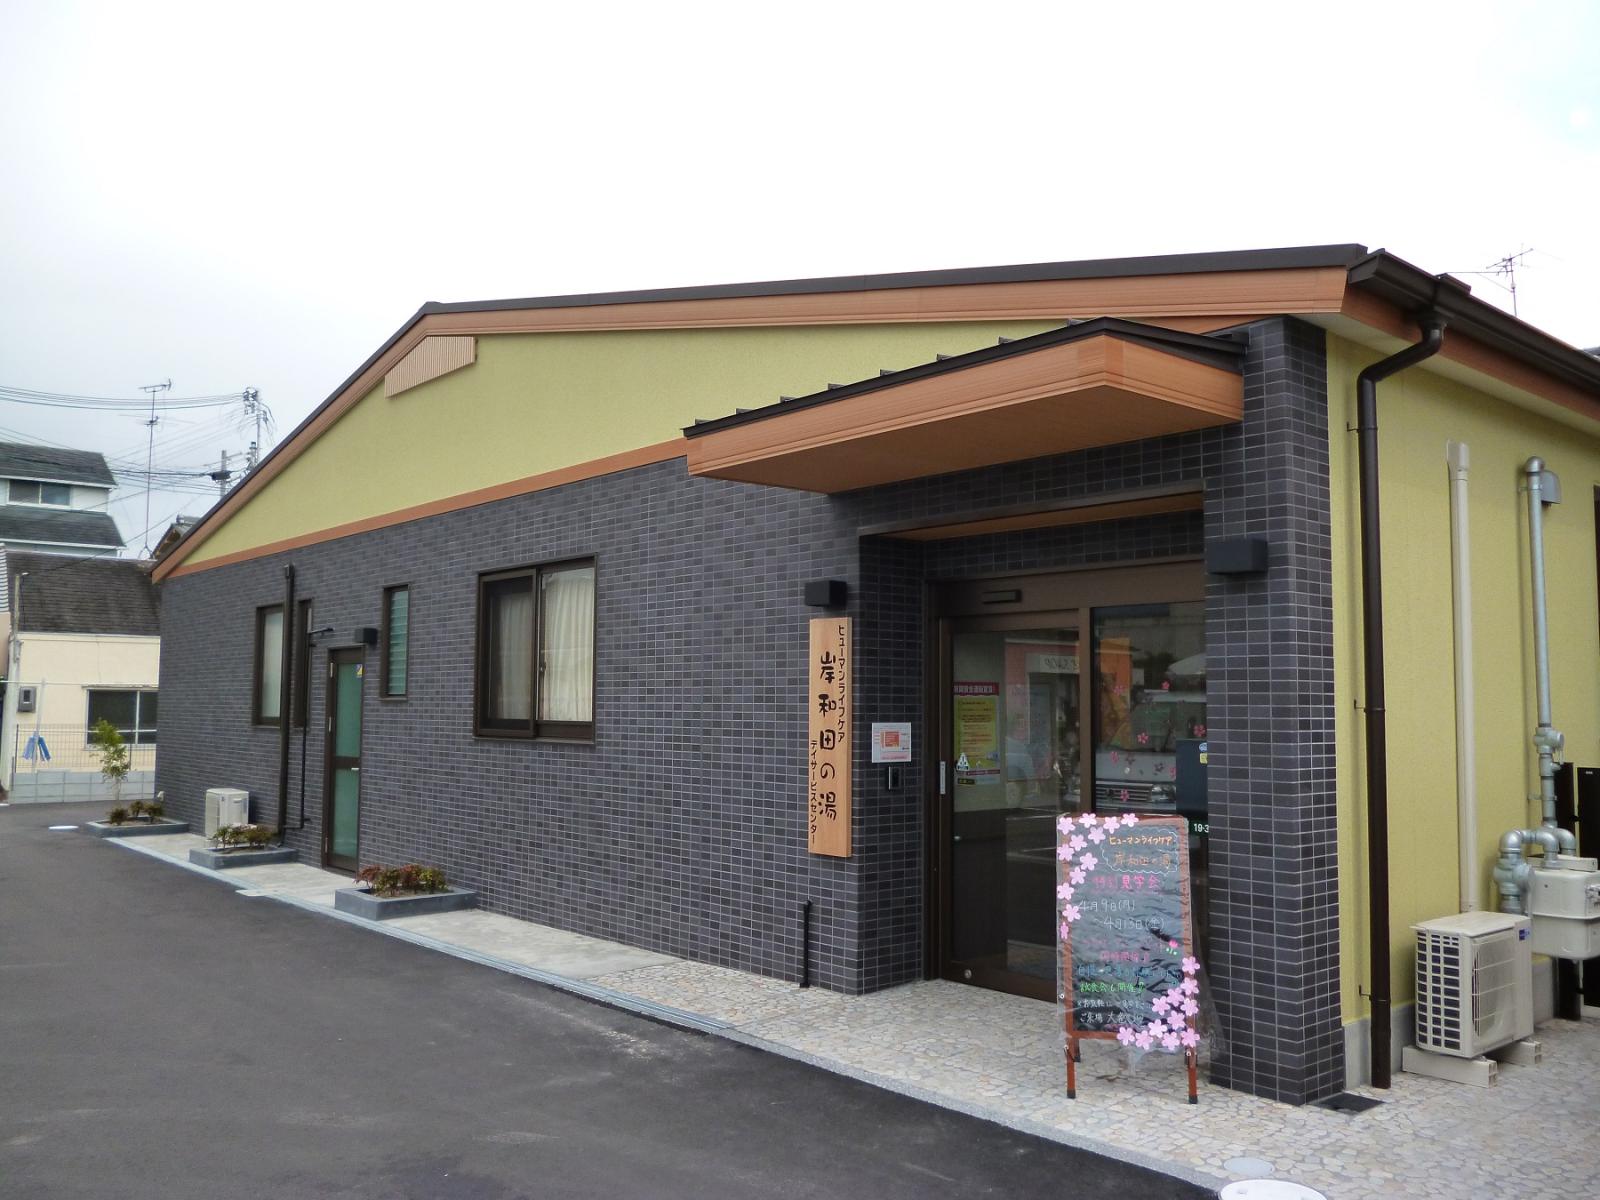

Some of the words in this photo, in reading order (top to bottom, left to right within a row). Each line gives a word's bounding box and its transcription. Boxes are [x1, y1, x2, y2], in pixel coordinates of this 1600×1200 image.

[818, 651, 837, 821] 岸和田の湯
[838, 624, 846, 743] ヒューマンライフケア
